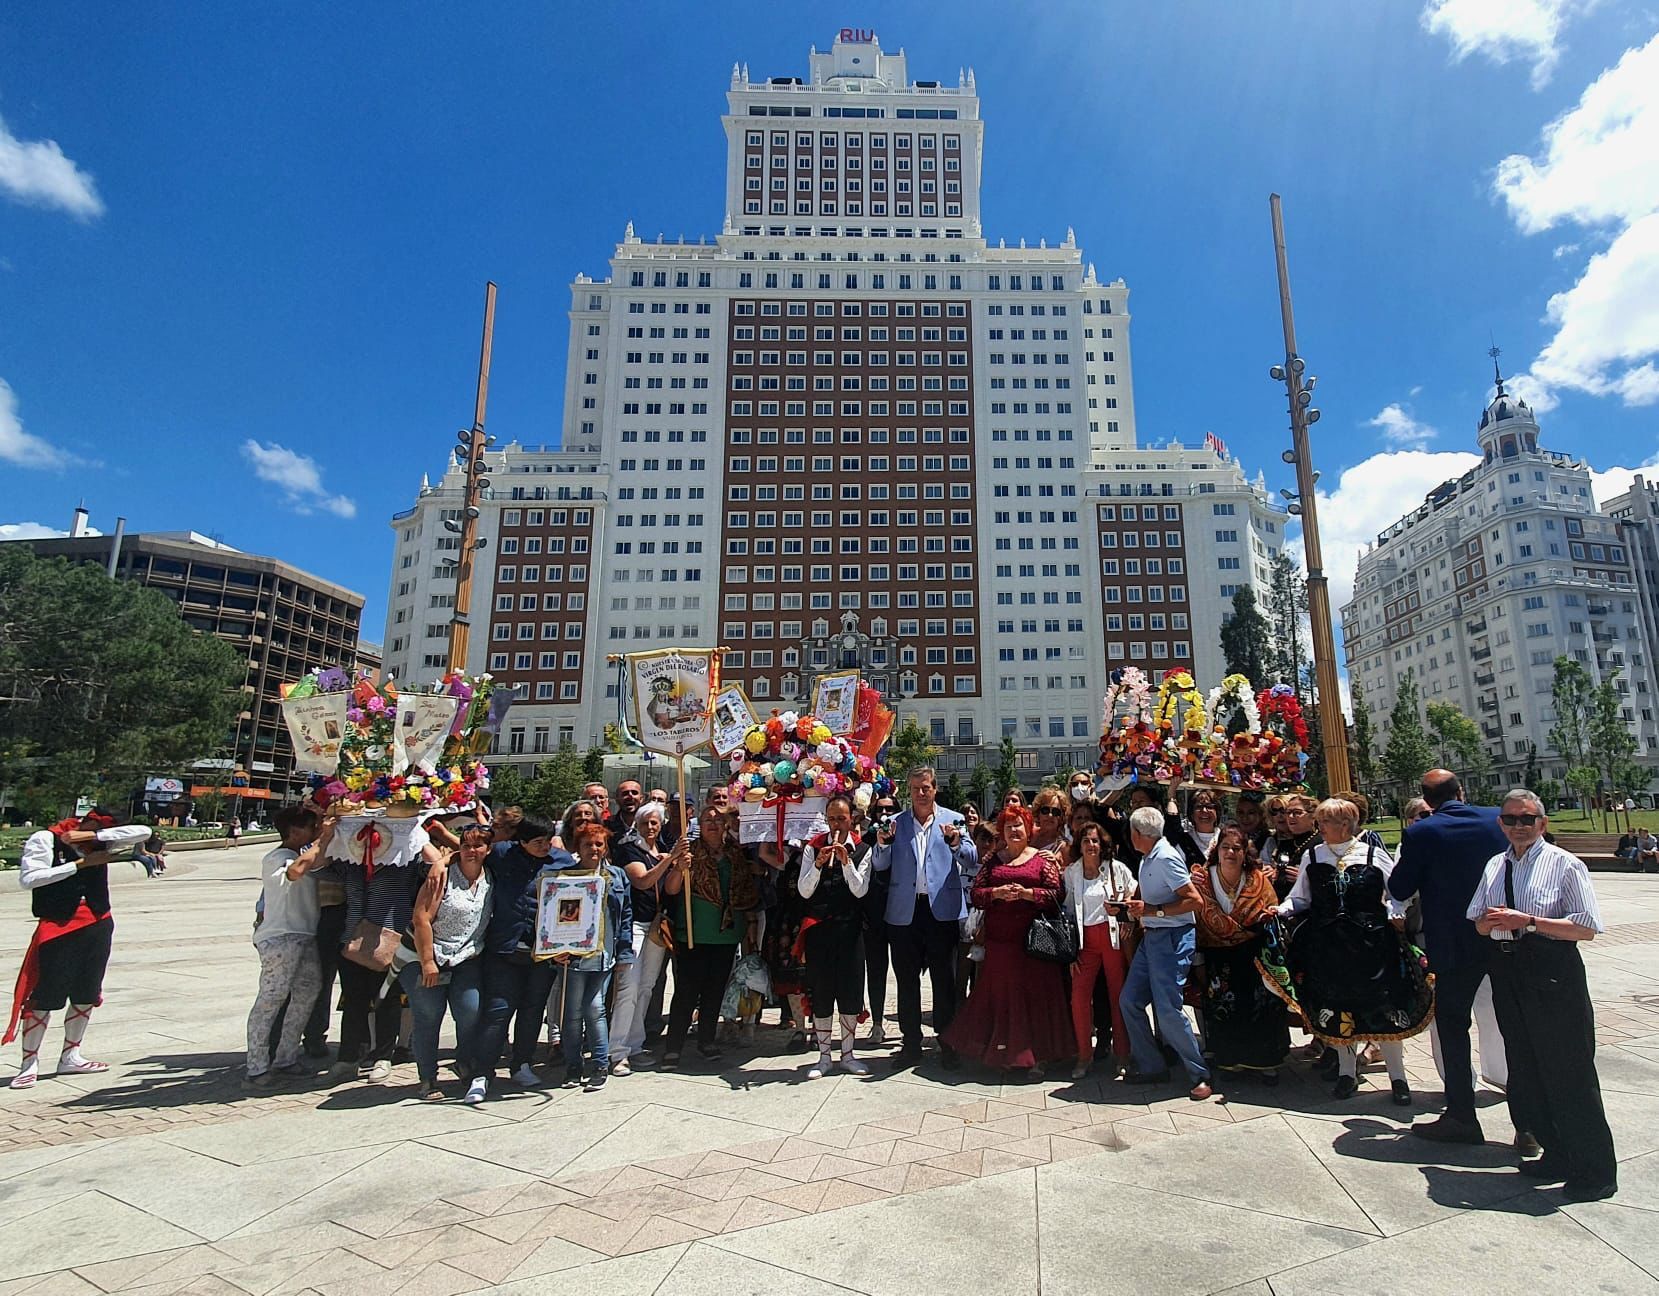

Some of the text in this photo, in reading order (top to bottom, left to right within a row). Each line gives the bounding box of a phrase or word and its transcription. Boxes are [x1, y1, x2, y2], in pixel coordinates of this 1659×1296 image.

[840, 28, 874, 42] RIU
[641, 663, 705, 679] VIRGEN DEL ROSARIO
[424, 709, 450, 719] Mateo
